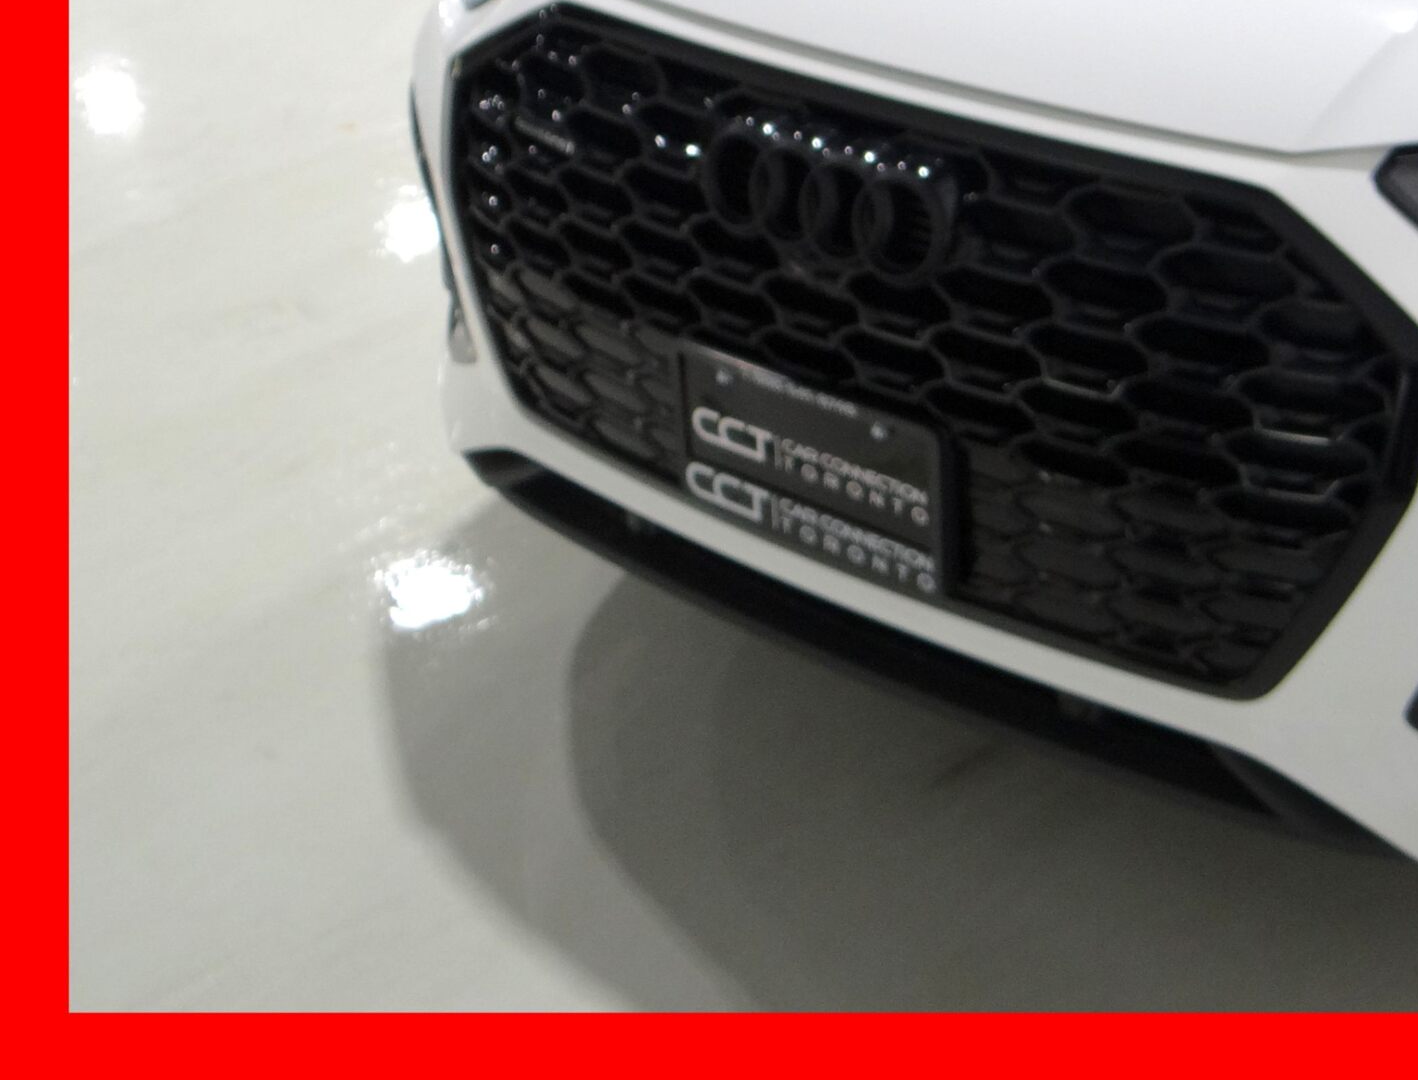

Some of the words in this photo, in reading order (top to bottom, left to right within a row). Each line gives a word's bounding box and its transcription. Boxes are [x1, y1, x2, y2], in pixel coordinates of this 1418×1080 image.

[691, 406, 773, 463] CCT
[685, 461, 769, 524] CCT
[784, 455, 930, 527] TORONTO
[819, 452, 929, 506] CONNECTION
[782, 516, 937, 594] TORONTO
[818, 513, 935, 571] CONNECTION
